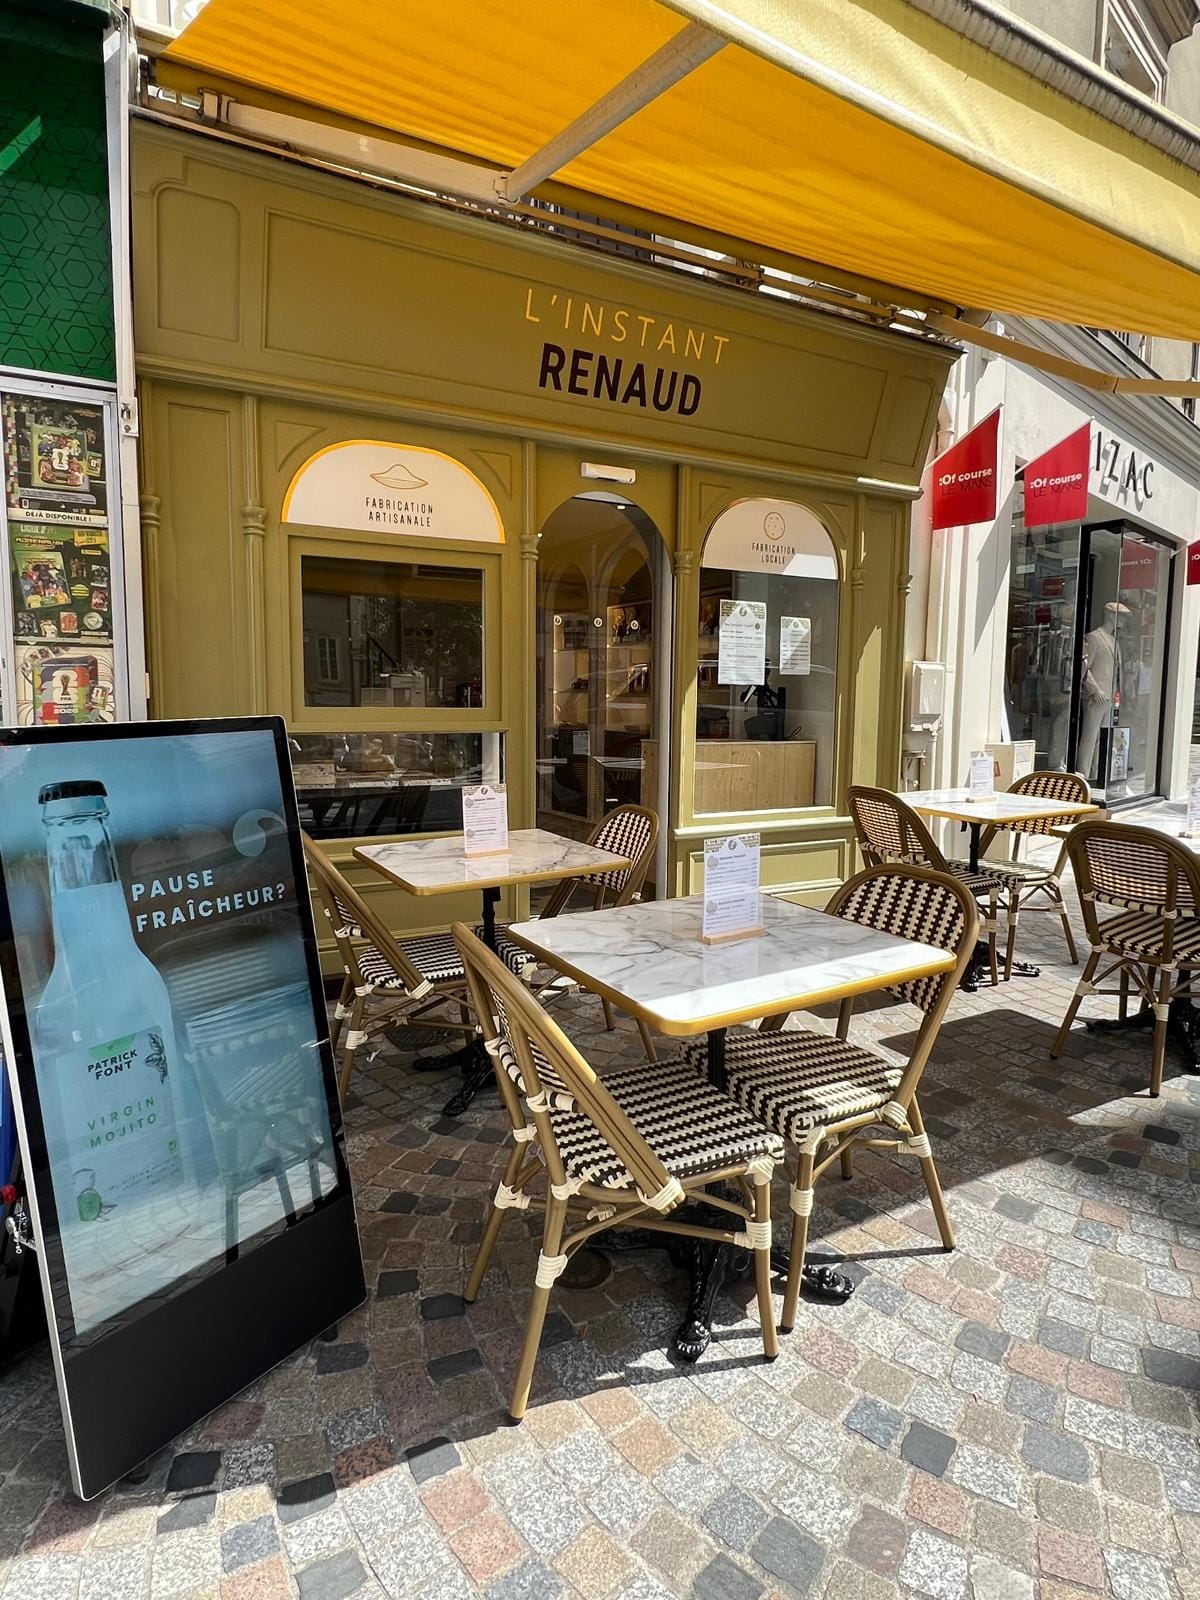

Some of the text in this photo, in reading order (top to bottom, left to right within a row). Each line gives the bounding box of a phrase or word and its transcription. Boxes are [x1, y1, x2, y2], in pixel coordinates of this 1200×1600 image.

[525, 288, 730, 364] L'INSTANT
[538, 342, 702, 416] RENAUD
[958, 468, 992, 481] course
[1095, 431, 1154, 499] IZAC
[942, 478, 992, 496] LE MANS
[1049, 473, 1082, 485] course
[1034, 481, 1081, 497] LE MANS
[365, 497, 433, 514] FABRICATION
[46, 513, 87, 522] DISPONIBLE
[368, 511, 431, 527] ARTISANALE
[751, 542, 795, 555] FABRICATION
[761, 554, 786, 565] LOCALE
[131, 869, 214, 902] PAUSE
[135, 883, 286, 932] FRAÎCHEUR?
[87, 1049, 138, 1073] PATRICK
[95, 1060, 133, 1080] FONT
[87, 1096, 155, 1131] VIRGIN
[89, 1113, 157, 1149] MOJITO
